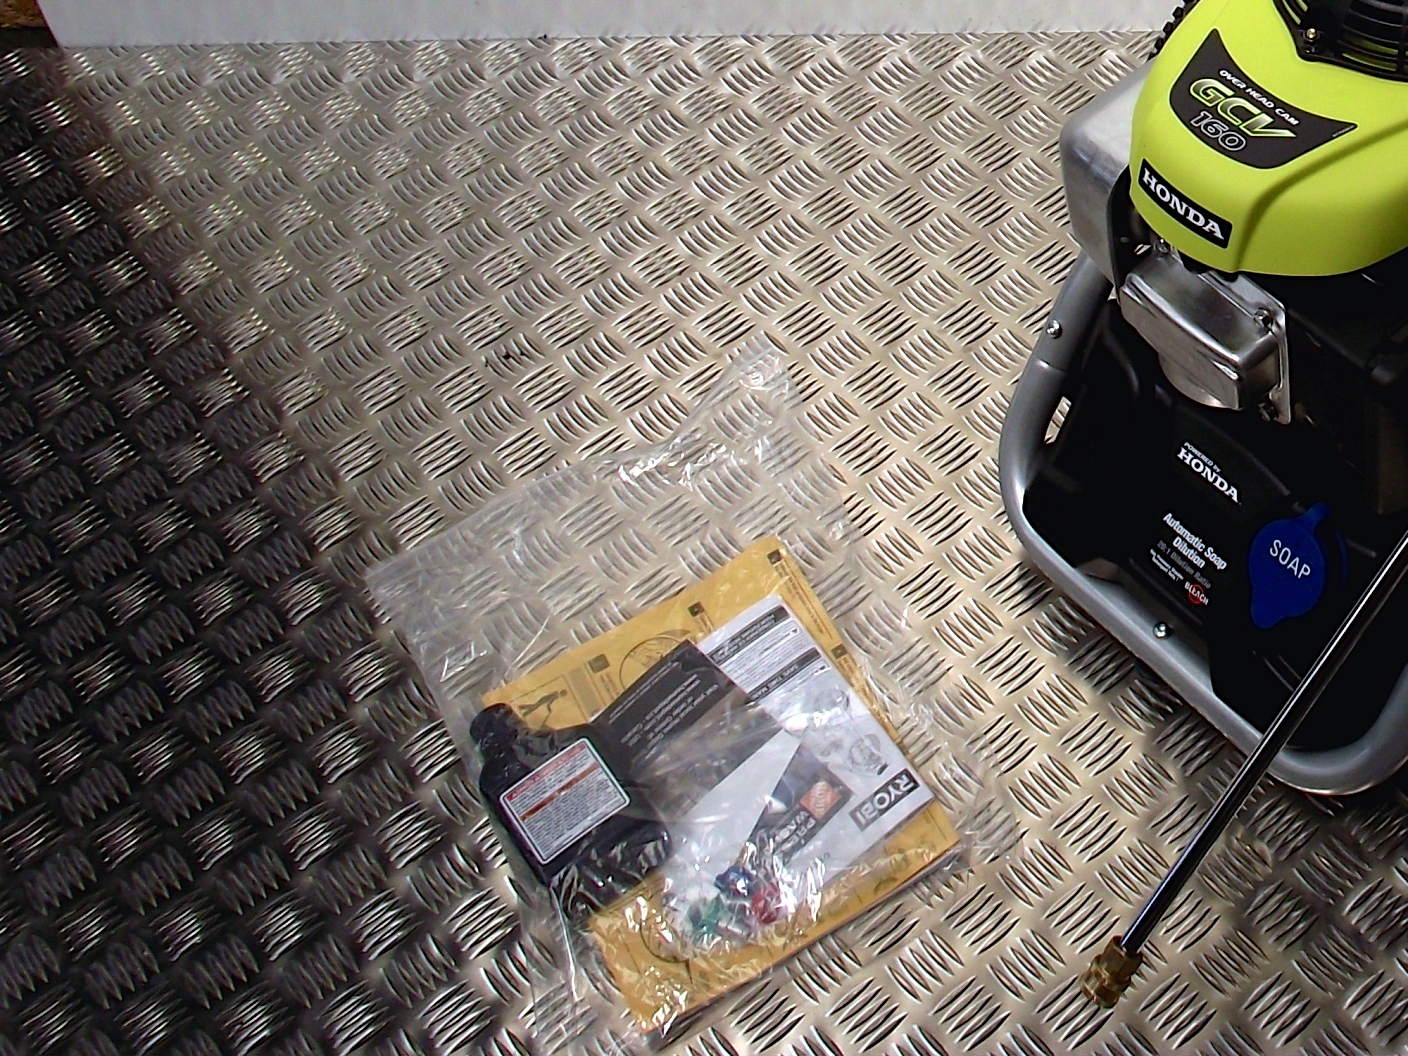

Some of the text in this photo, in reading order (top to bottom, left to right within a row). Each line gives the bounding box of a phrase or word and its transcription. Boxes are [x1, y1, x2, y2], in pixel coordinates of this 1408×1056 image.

[1190, 78, 1297, 138] GCV
[1219, 69, 1299, 125] OVER HEAD CAM
[1190, 111, 1246, 151] 160
[1142, 168, 1224, 240] HONDA
[1177, 447, 1239, 503] HONDA
[1184, 442, 1213, 466] POWERED
[1163, 513, 1227, 570] Automatic Soap
[1172, 536, 1205, 569] Dilution
[1269, 539, 1311, 579] SOAP
[1170, 551, 1194, 575] Dilution
[1194, 571, 1211, 589] Ratio
[1184, 581, 1209, 605] BLEACH
[856, 775, 915, 825] RYOBI
